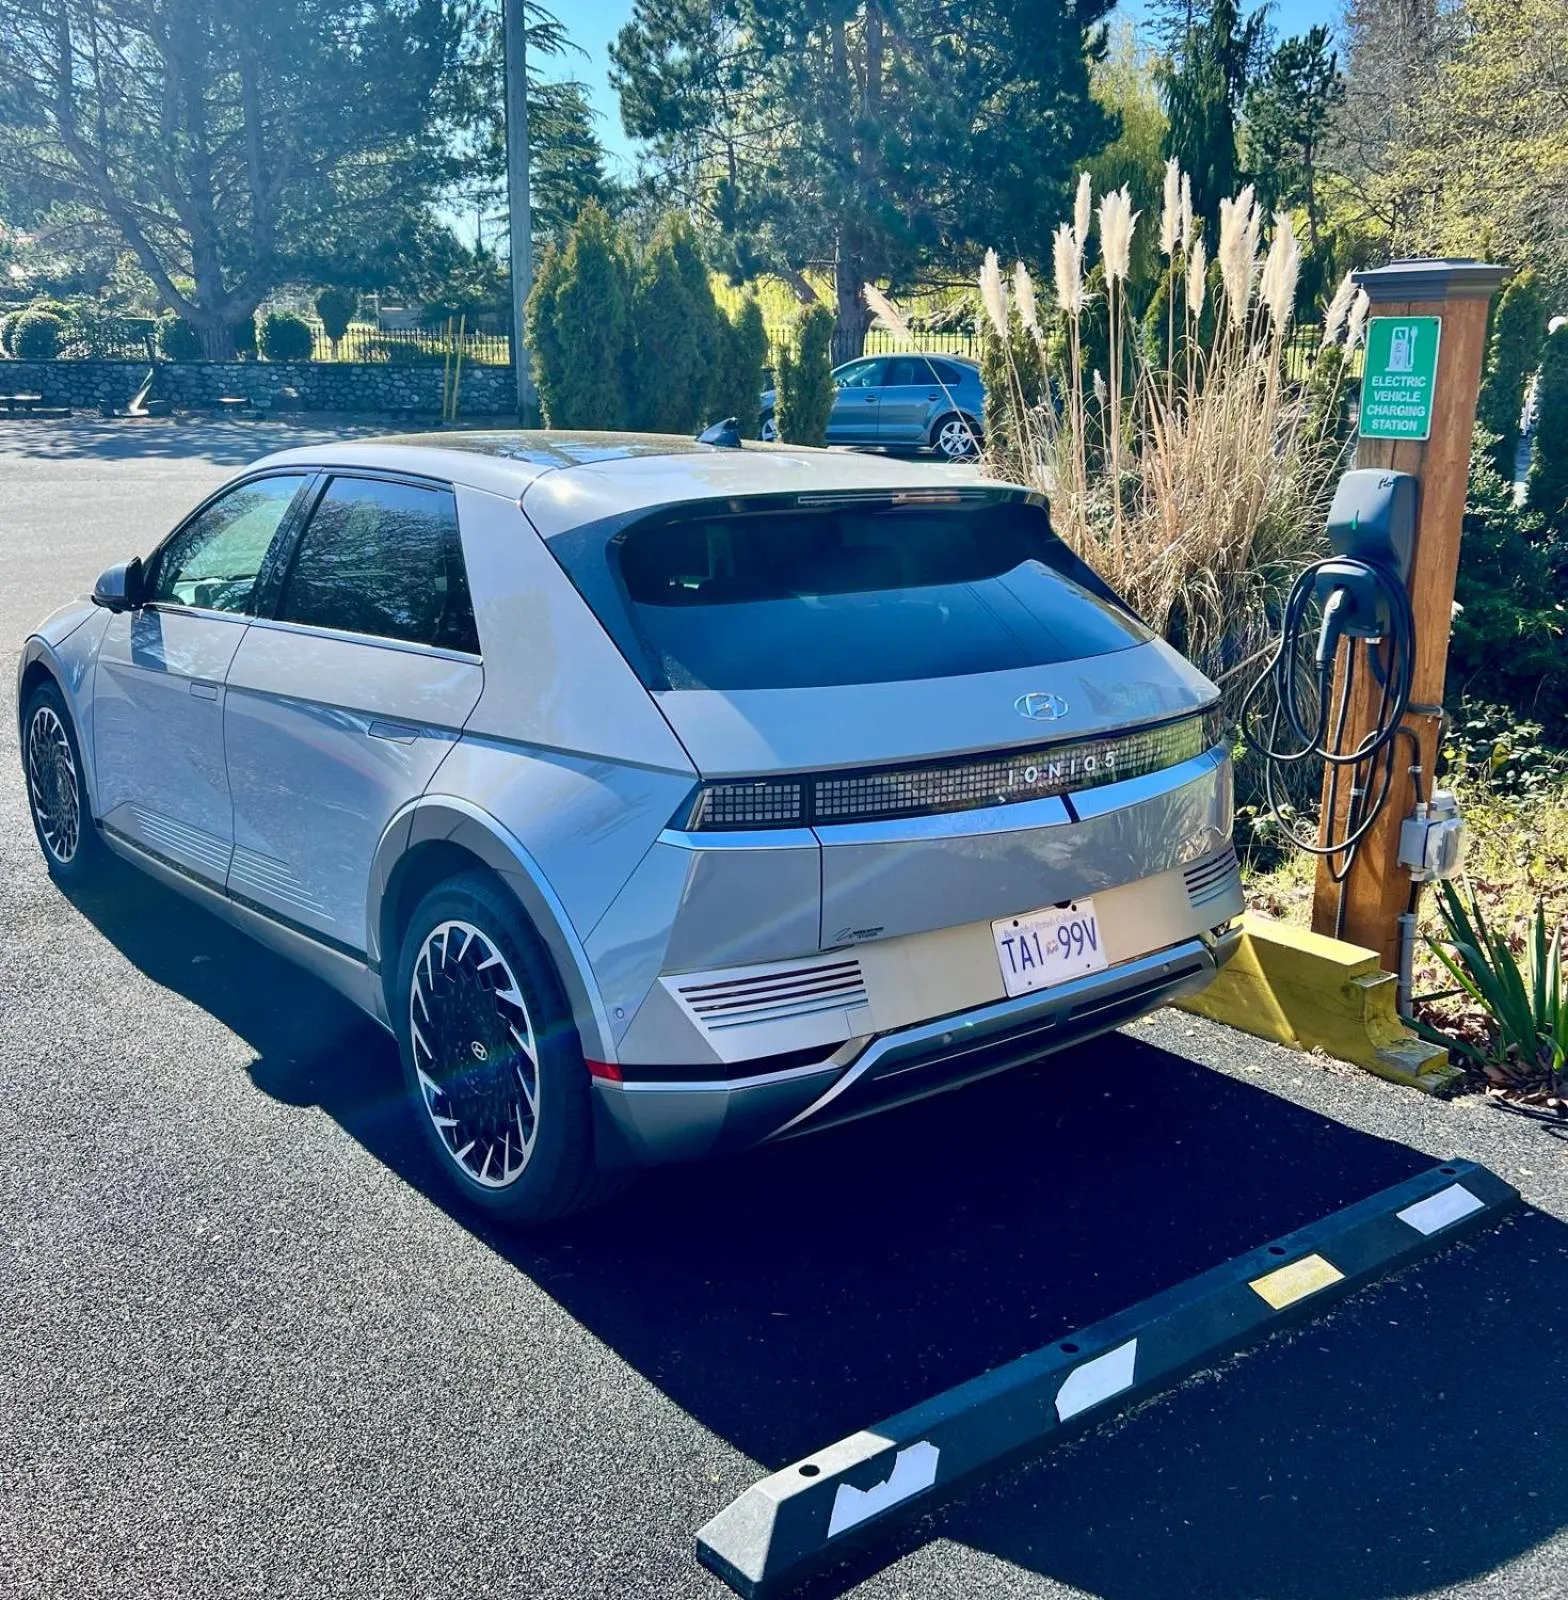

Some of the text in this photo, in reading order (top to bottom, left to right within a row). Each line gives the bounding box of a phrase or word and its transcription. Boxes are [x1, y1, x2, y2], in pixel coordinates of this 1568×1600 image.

[1372, 375, 1426, 387] ELECTRIC
[1373, 391, 1421, 403] VEHICLE
[1366, 404, 1426, 417] CHARGING
[1371, 419, 1418, 431] STATION
[1008, 750, 1116, 786] IONIQ 5
[1001, 931, 1044, 974] TA1
[1057, 916, 1098, 960] 99V
